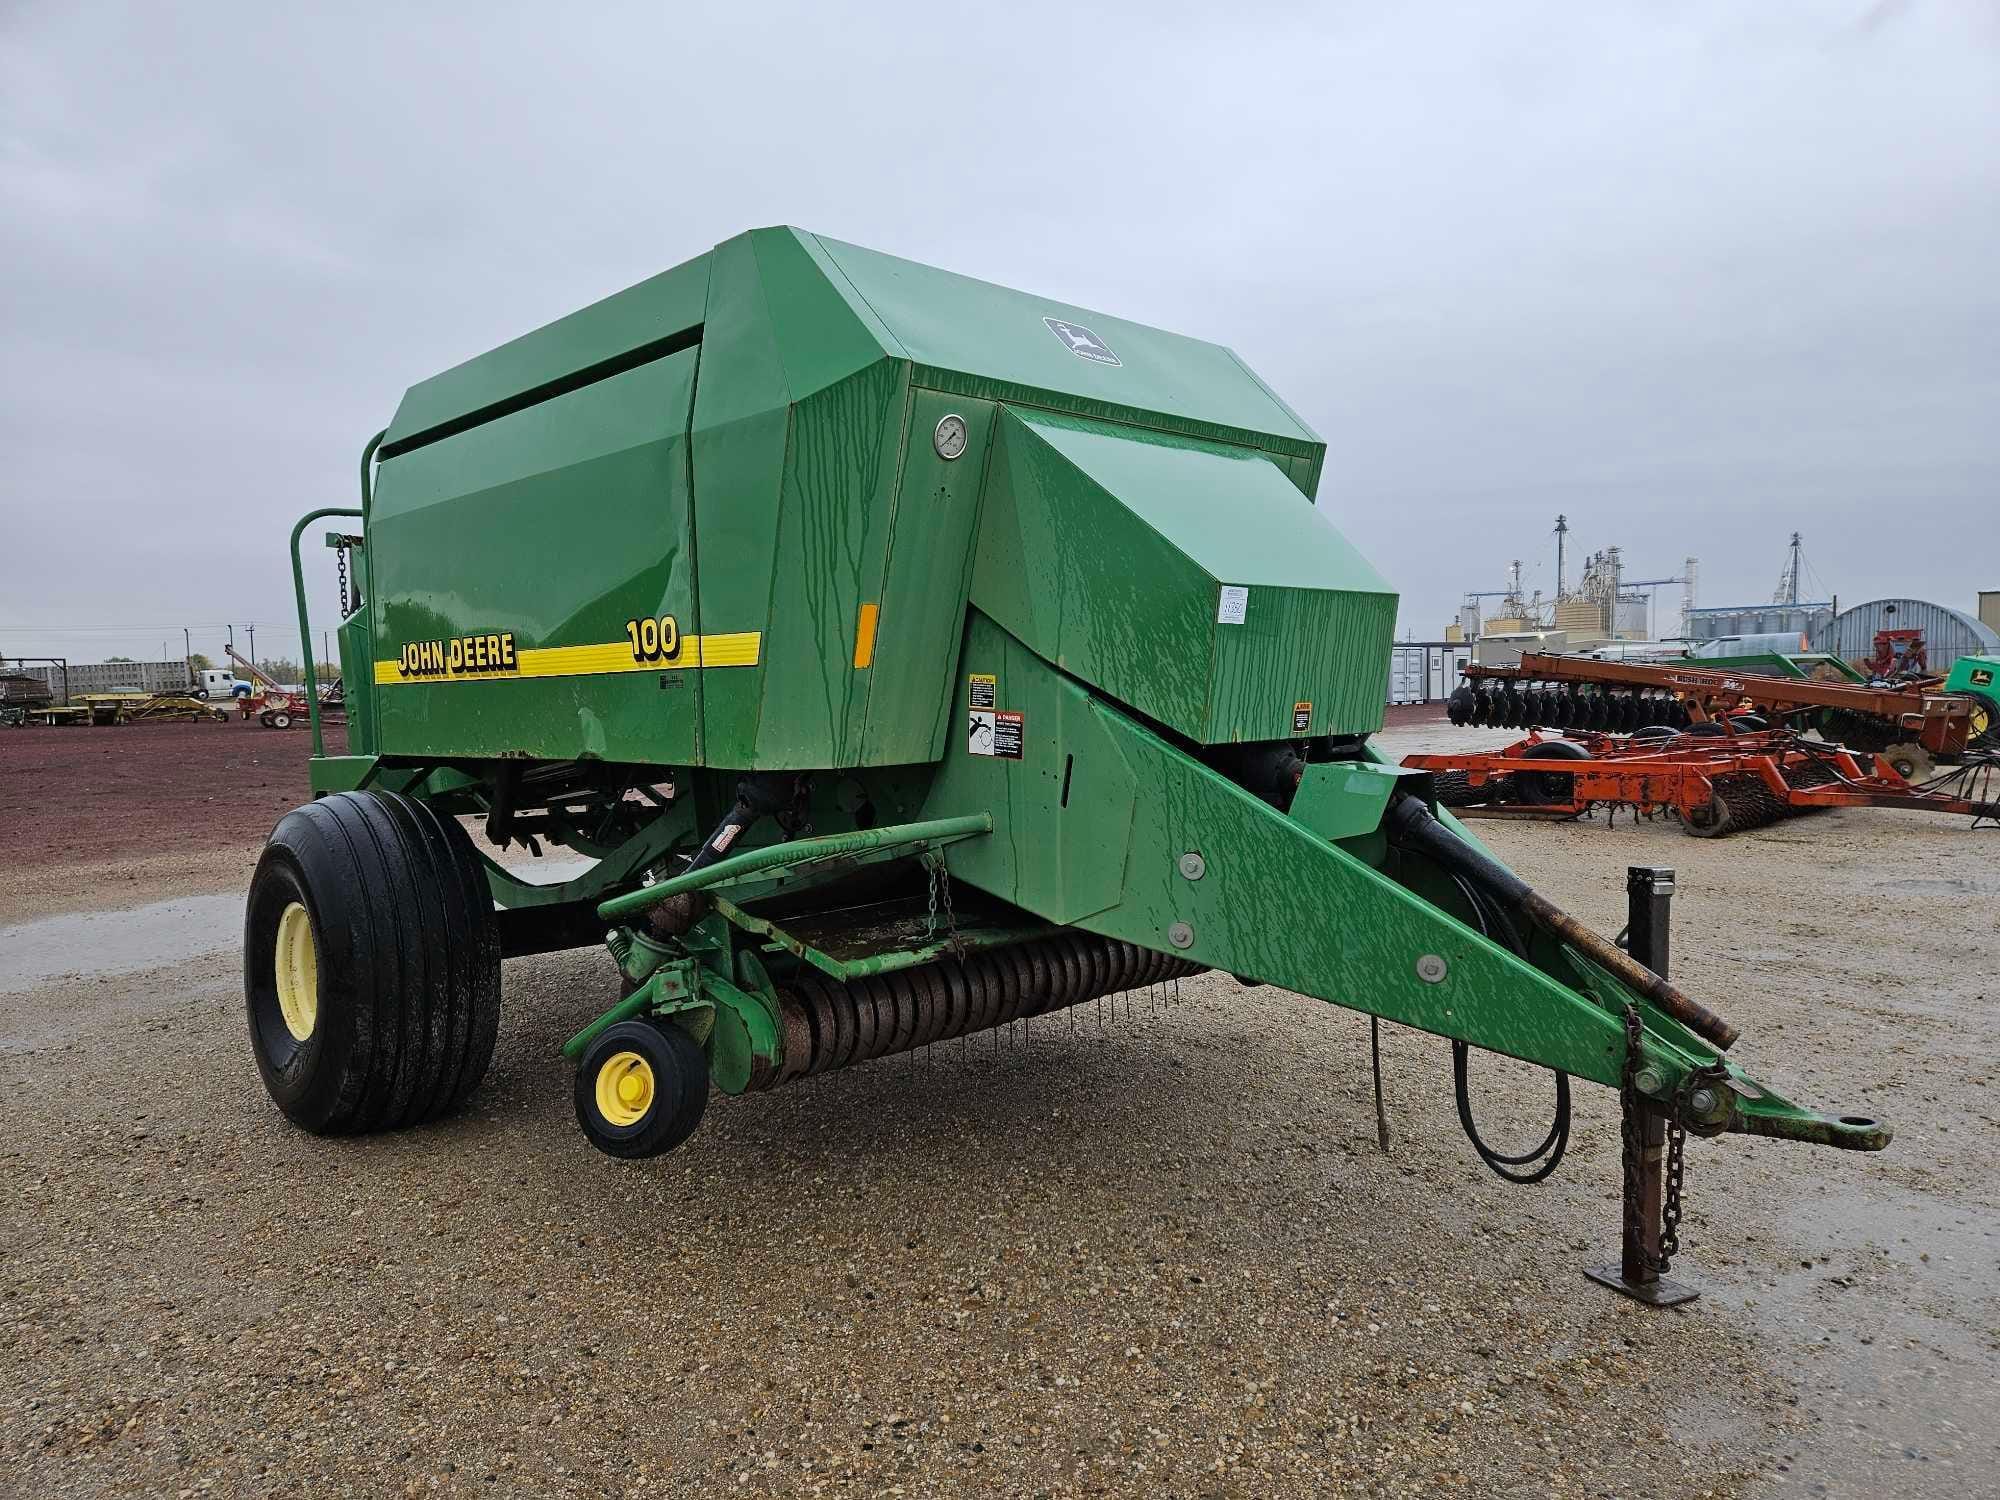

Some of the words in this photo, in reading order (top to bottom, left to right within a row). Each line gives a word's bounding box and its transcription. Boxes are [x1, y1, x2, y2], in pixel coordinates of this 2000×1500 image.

[397, 640, 446, 675] JOHN
[449, 632, 517, 673] DEERE
[626, 615, 680, 662] 100
